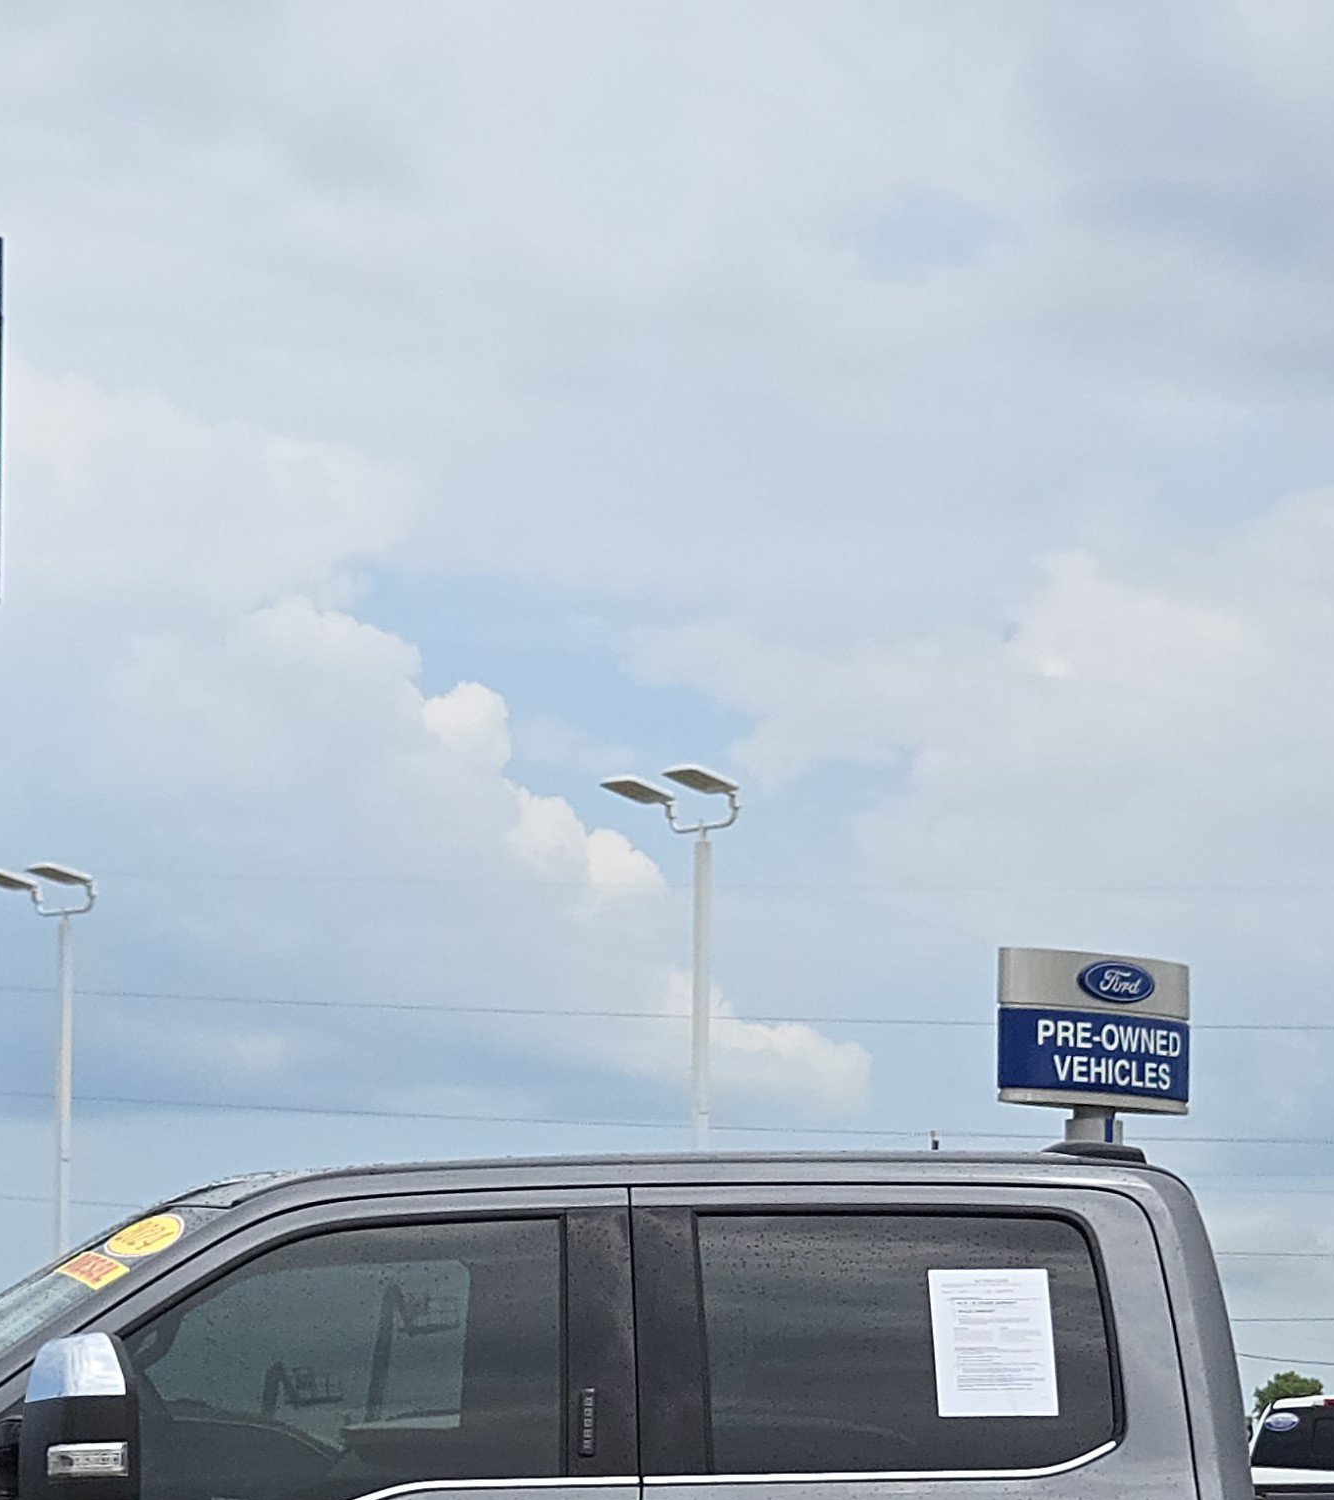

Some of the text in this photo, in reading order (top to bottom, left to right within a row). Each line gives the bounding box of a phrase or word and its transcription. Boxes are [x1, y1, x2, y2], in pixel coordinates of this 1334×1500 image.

[1099, 970, 1142, 994] Ford
[1036, 1019, 1181, 1058] PRE-OWNED
[1053, 1055, 1171, 1090] VEHICLES
